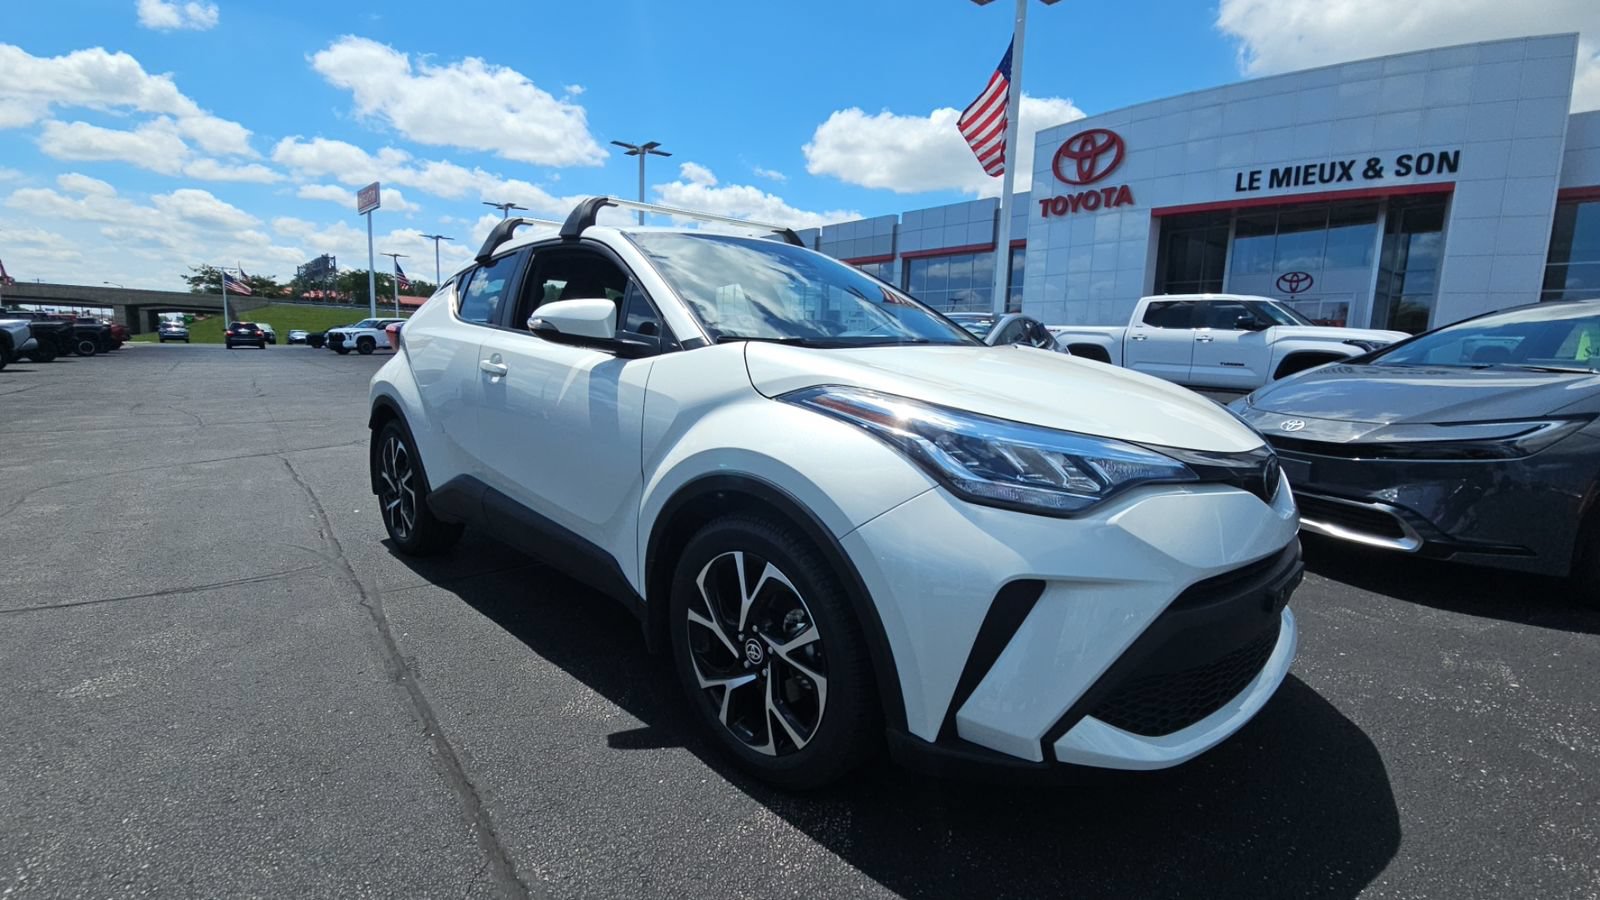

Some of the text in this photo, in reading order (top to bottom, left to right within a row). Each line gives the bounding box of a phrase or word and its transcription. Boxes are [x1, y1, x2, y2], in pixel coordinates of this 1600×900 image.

[1235, 150, 1460, 192] LE MIEUX & SON
[1039, 185, 1135, 218] TOYOTA
